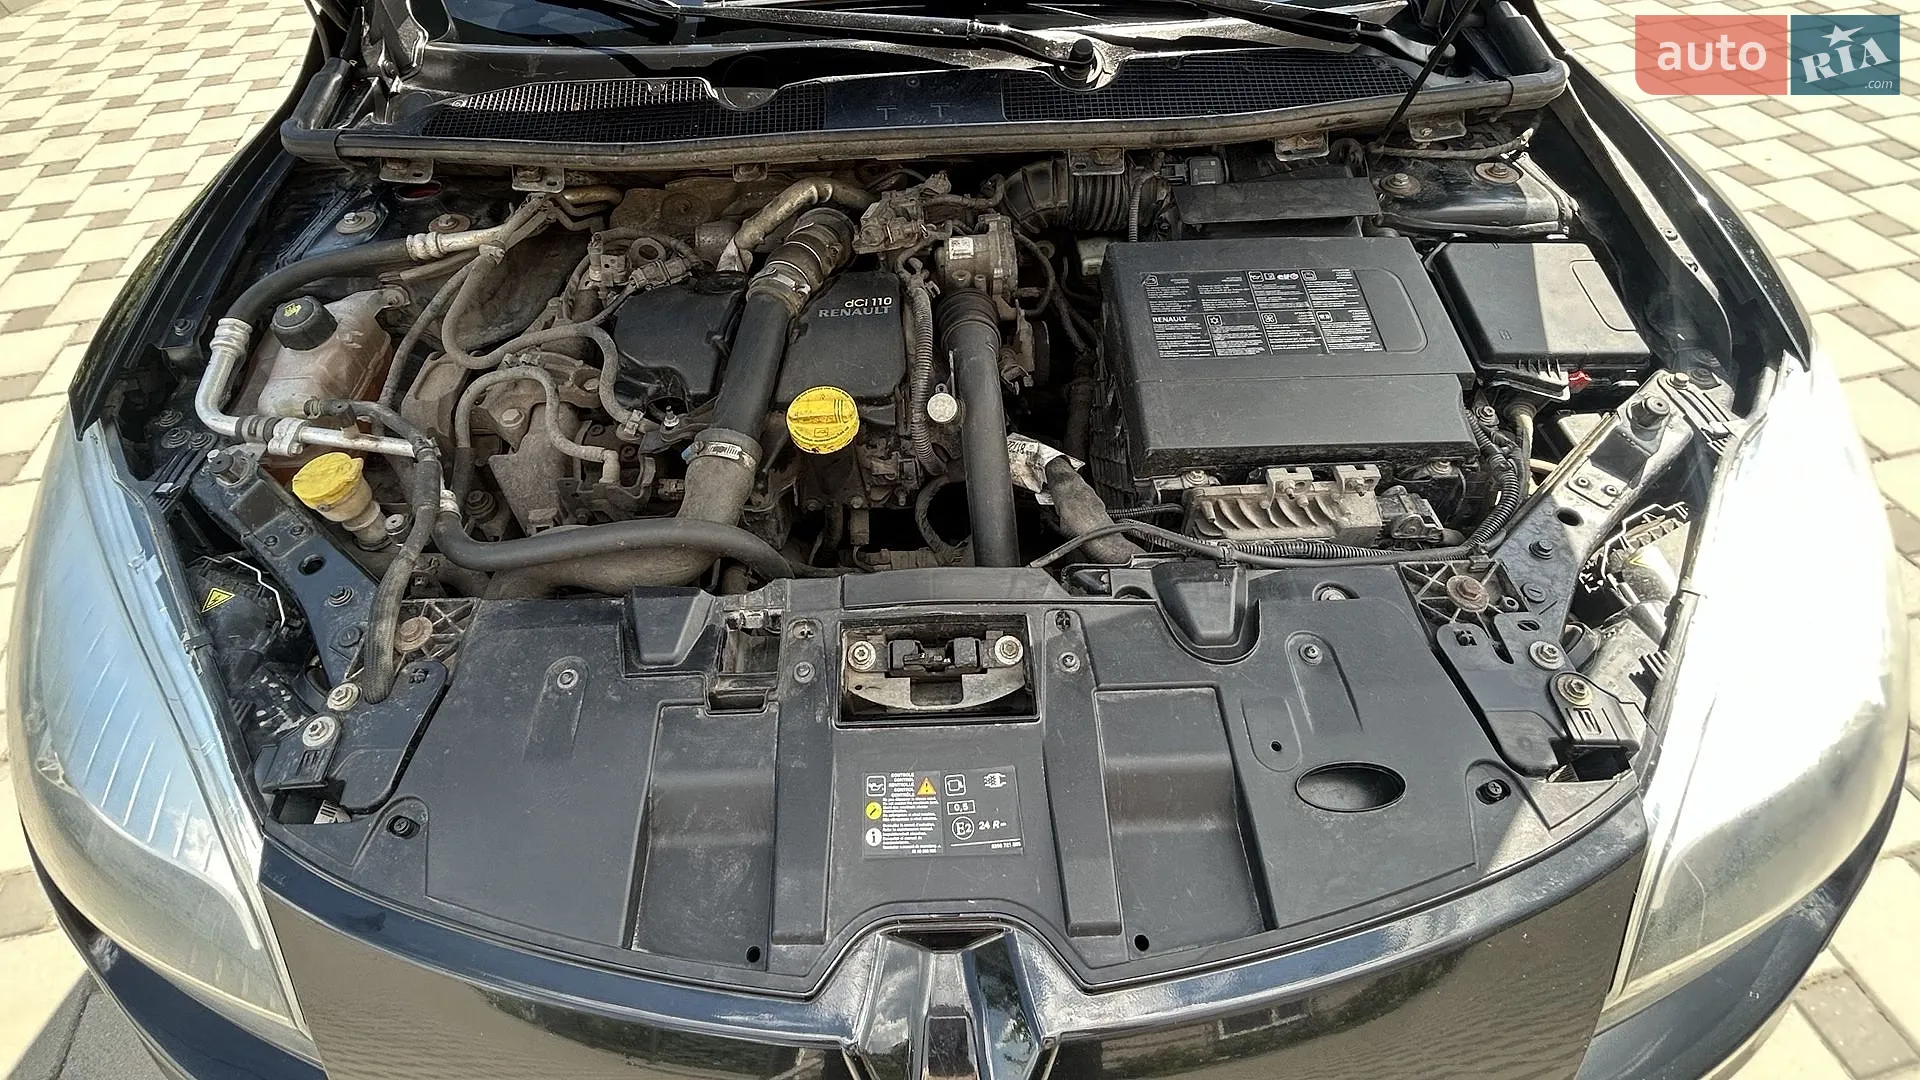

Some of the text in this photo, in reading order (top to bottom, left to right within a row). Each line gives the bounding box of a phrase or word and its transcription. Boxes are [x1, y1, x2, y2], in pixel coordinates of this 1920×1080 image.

[872, 296, 893, 306] 110
[818, 306, 892, 318] RENAULT
[1151, 315, 1188, 323] RENAULT
[953, 803, 969, 812] 0,5
[955, 821, 972, 836] E2
[978, 820, 991, 830] 24
